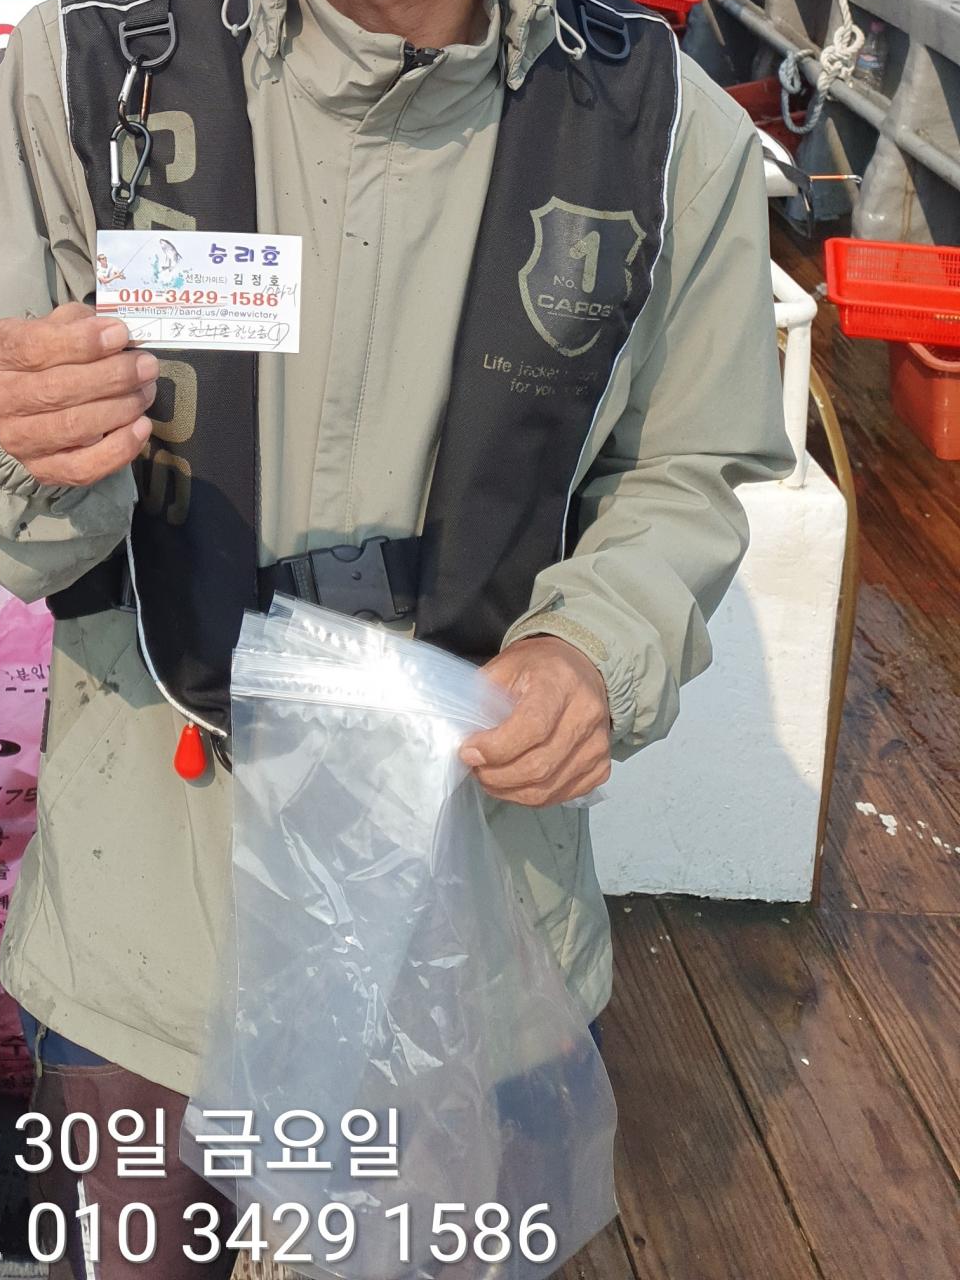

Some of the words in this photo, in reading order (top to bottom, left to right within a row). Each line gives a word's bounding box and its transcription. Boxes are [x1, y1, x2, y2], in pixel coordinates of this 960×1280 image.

[208, 243, 281, 266] 승리호
[118, 288, 279, 307] 010-3429-1586
[483, 354, 512, 373] Life
[517, 361, 561, 380] jacke
